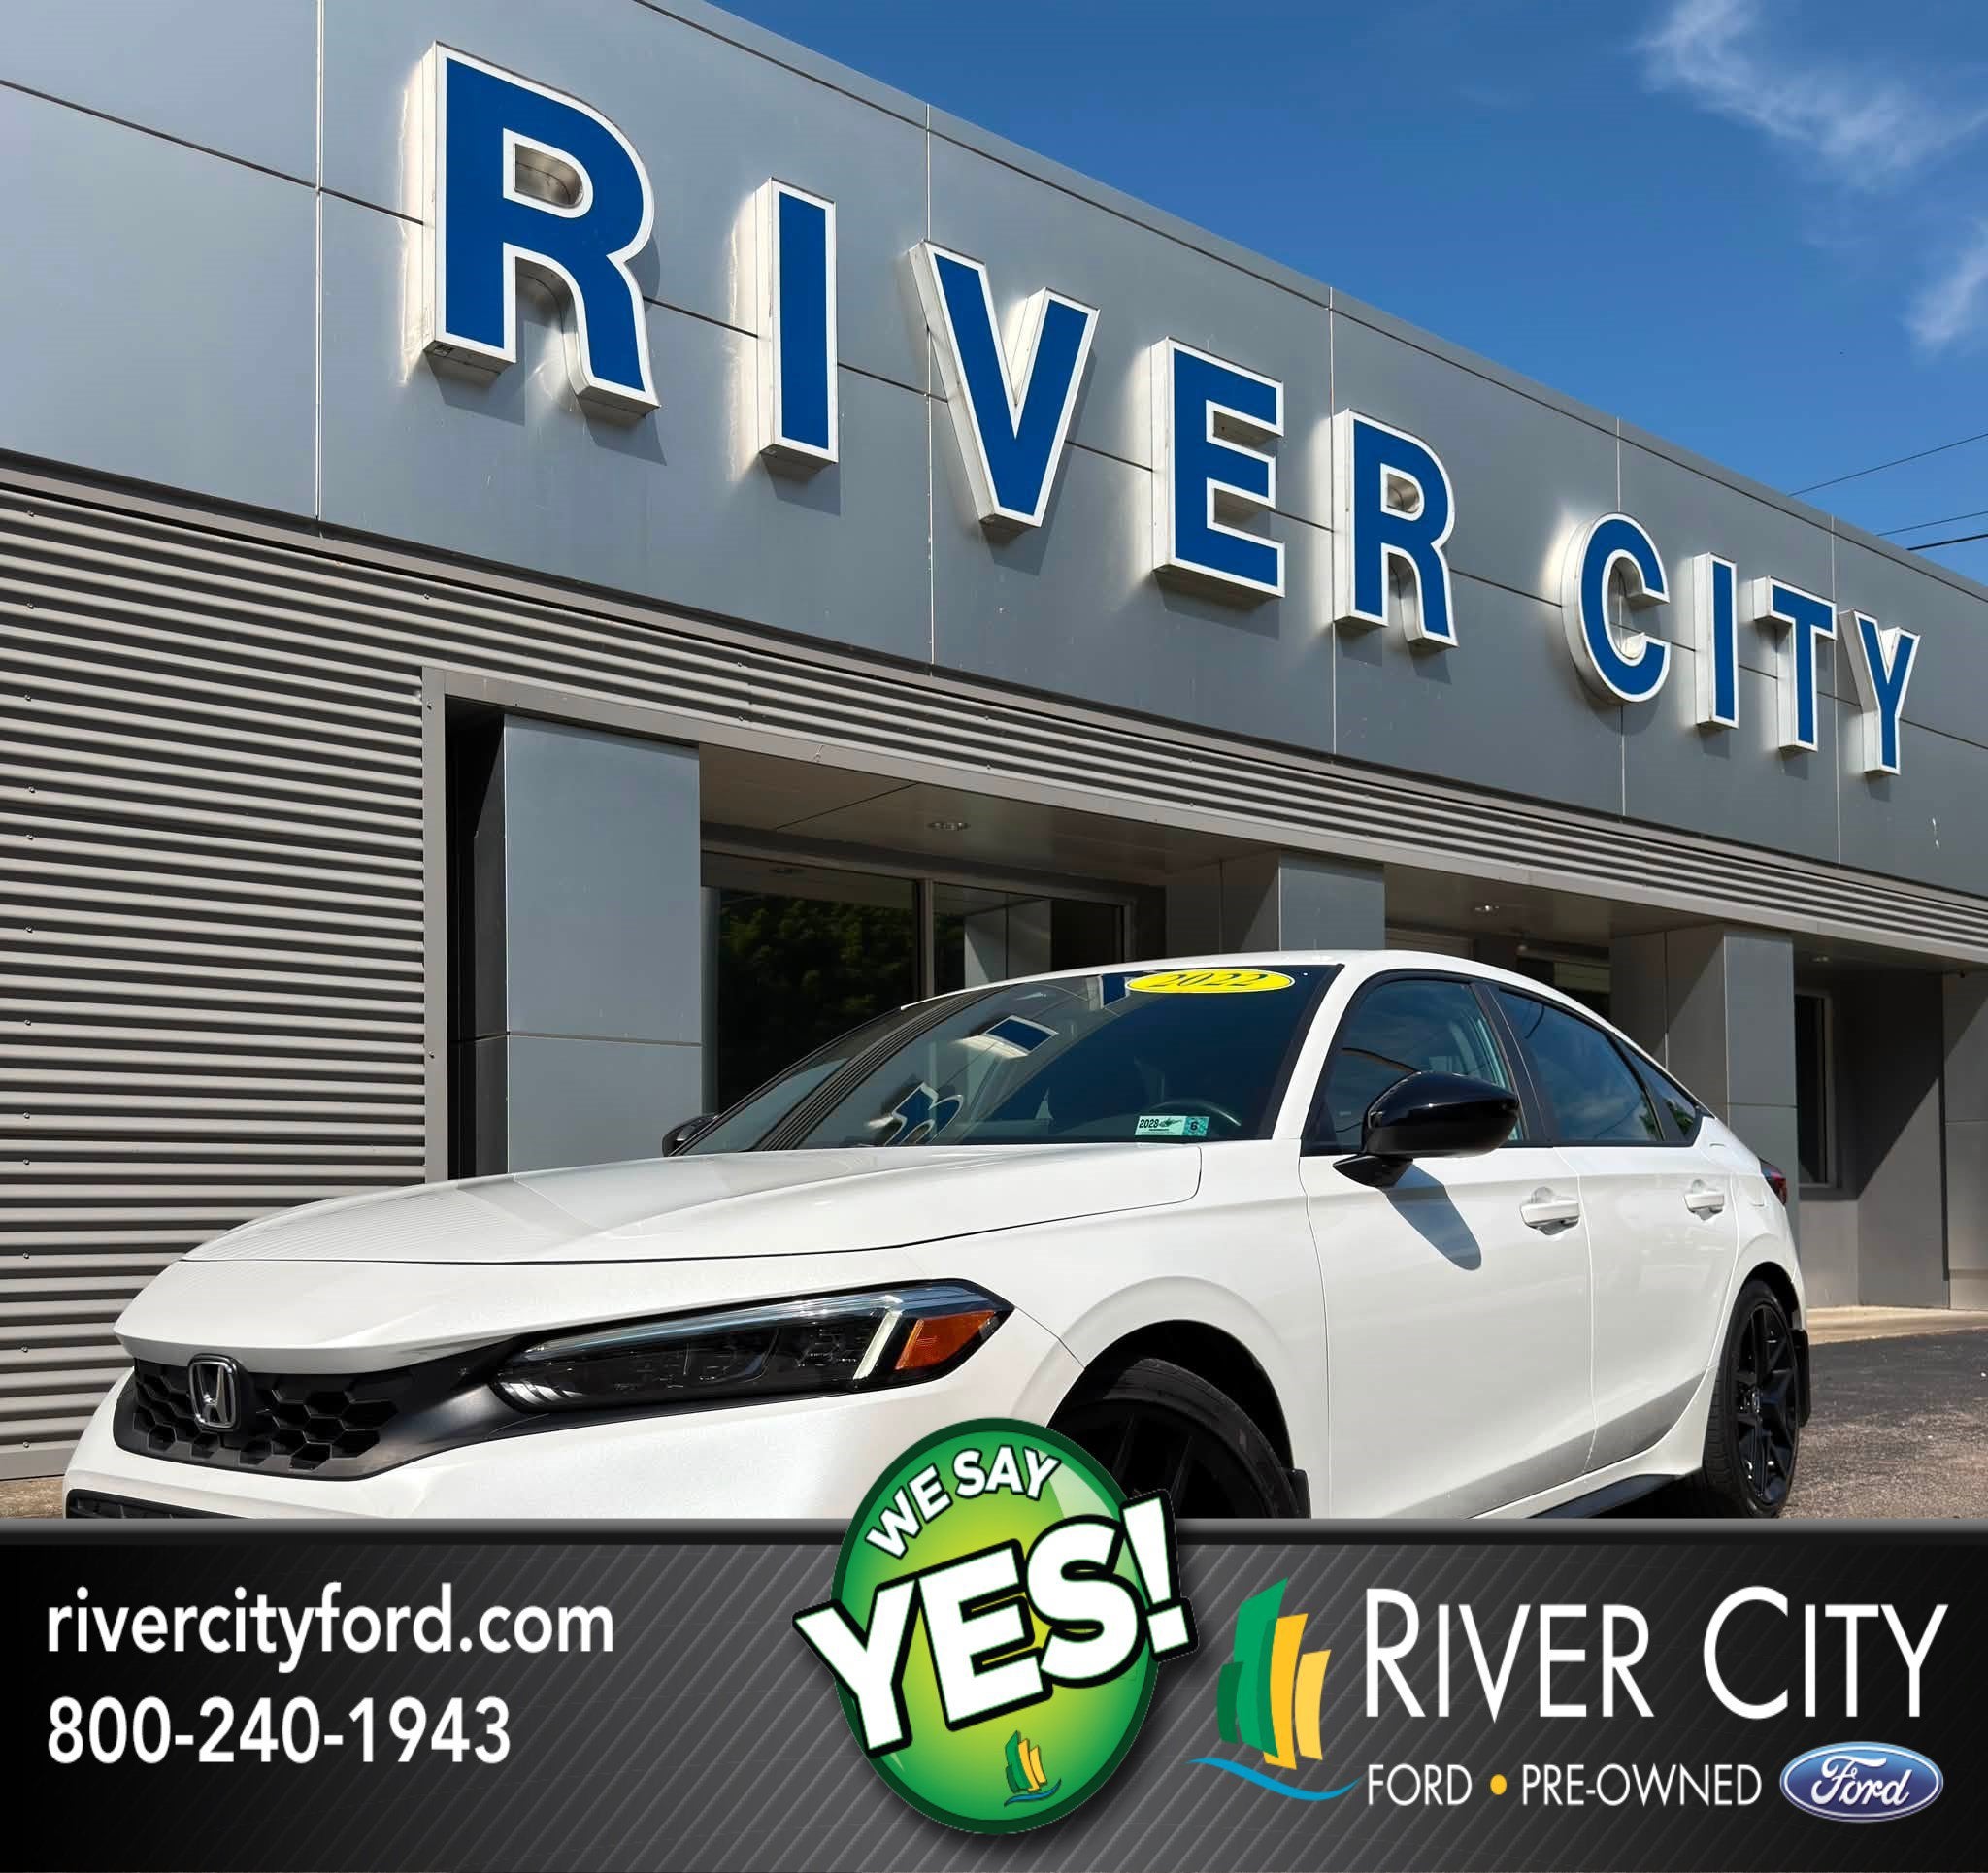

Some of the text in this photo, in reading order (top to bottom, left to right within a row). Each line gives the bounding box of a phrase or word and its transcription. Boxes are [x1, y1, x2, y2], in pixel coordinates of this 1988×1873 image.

[425, 42, 1920, 775] RIVER CITY
[1149, 972, 1269, 987] 2022
[1190, 1121, 1199, 1131] 6
